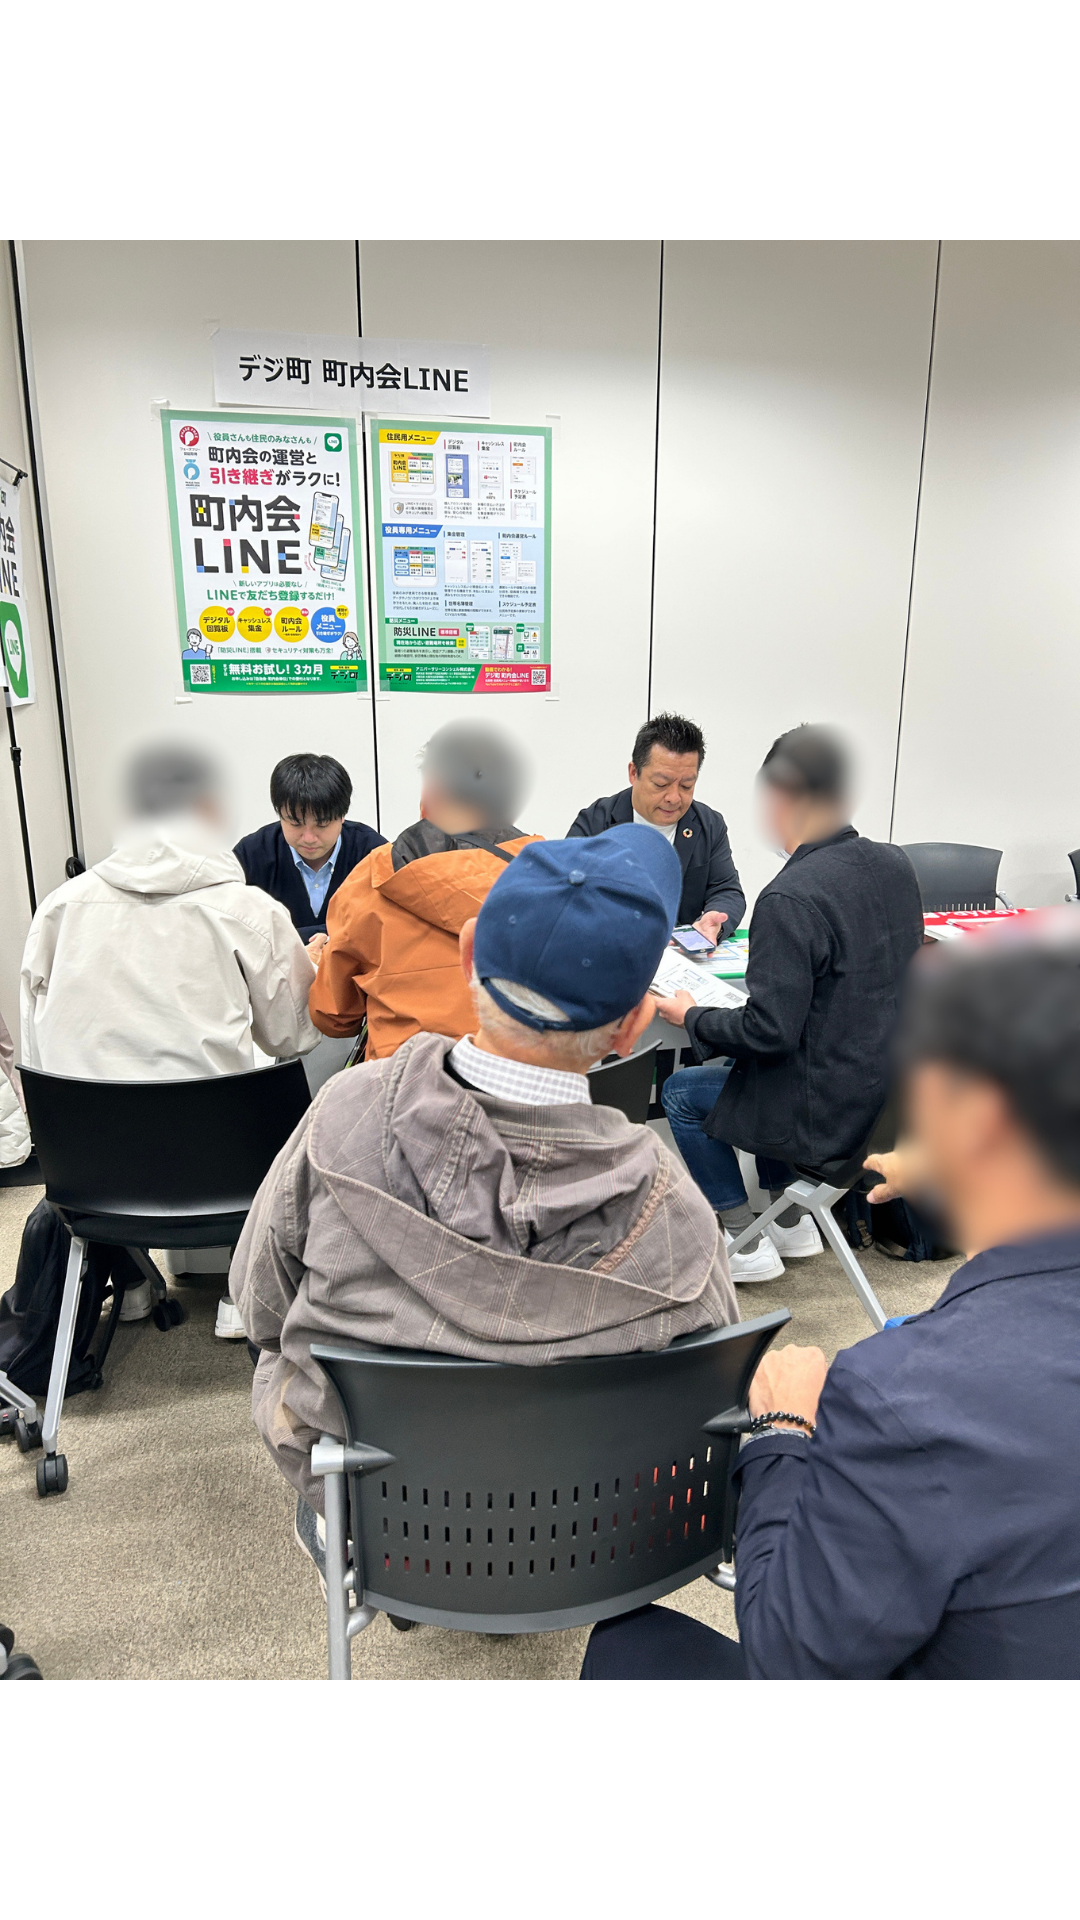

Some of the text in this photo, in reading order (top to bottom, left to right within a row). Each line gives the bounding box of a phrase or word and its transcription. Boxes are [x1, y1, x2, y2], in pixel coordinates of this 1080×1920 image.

[239, 355, 469, 393] デジ町 町内会LINE
[213, 432, 312, 444] 役員さんも住民のみなさんも
[387, 432, 433, 442] 住民用メニュー
[208, 446, 317, 466] 町内会の運営と
[210, 467, 341, 487] 引き継ぎがラクに!
[190, 494, 301, 533] 町内会
[385, 526, 437, 535] 役員専用メニュー
[238, 580, 303, 588] 新しいアプリは必要なし
[207, 589, 335, 601] LINEで友だち登録するだけ!
[281, 617, 302, 625] 町内会
[321, 614, 336, 623] 役員
[206, 625, 229, 633] 回覧板
[248, 624, 262, 632] 集金
[393, 627, 436, 637] 防災LINE
[7, 638, 20, 656] LINE
[229, 663, 290, 675] 無料お試し!
